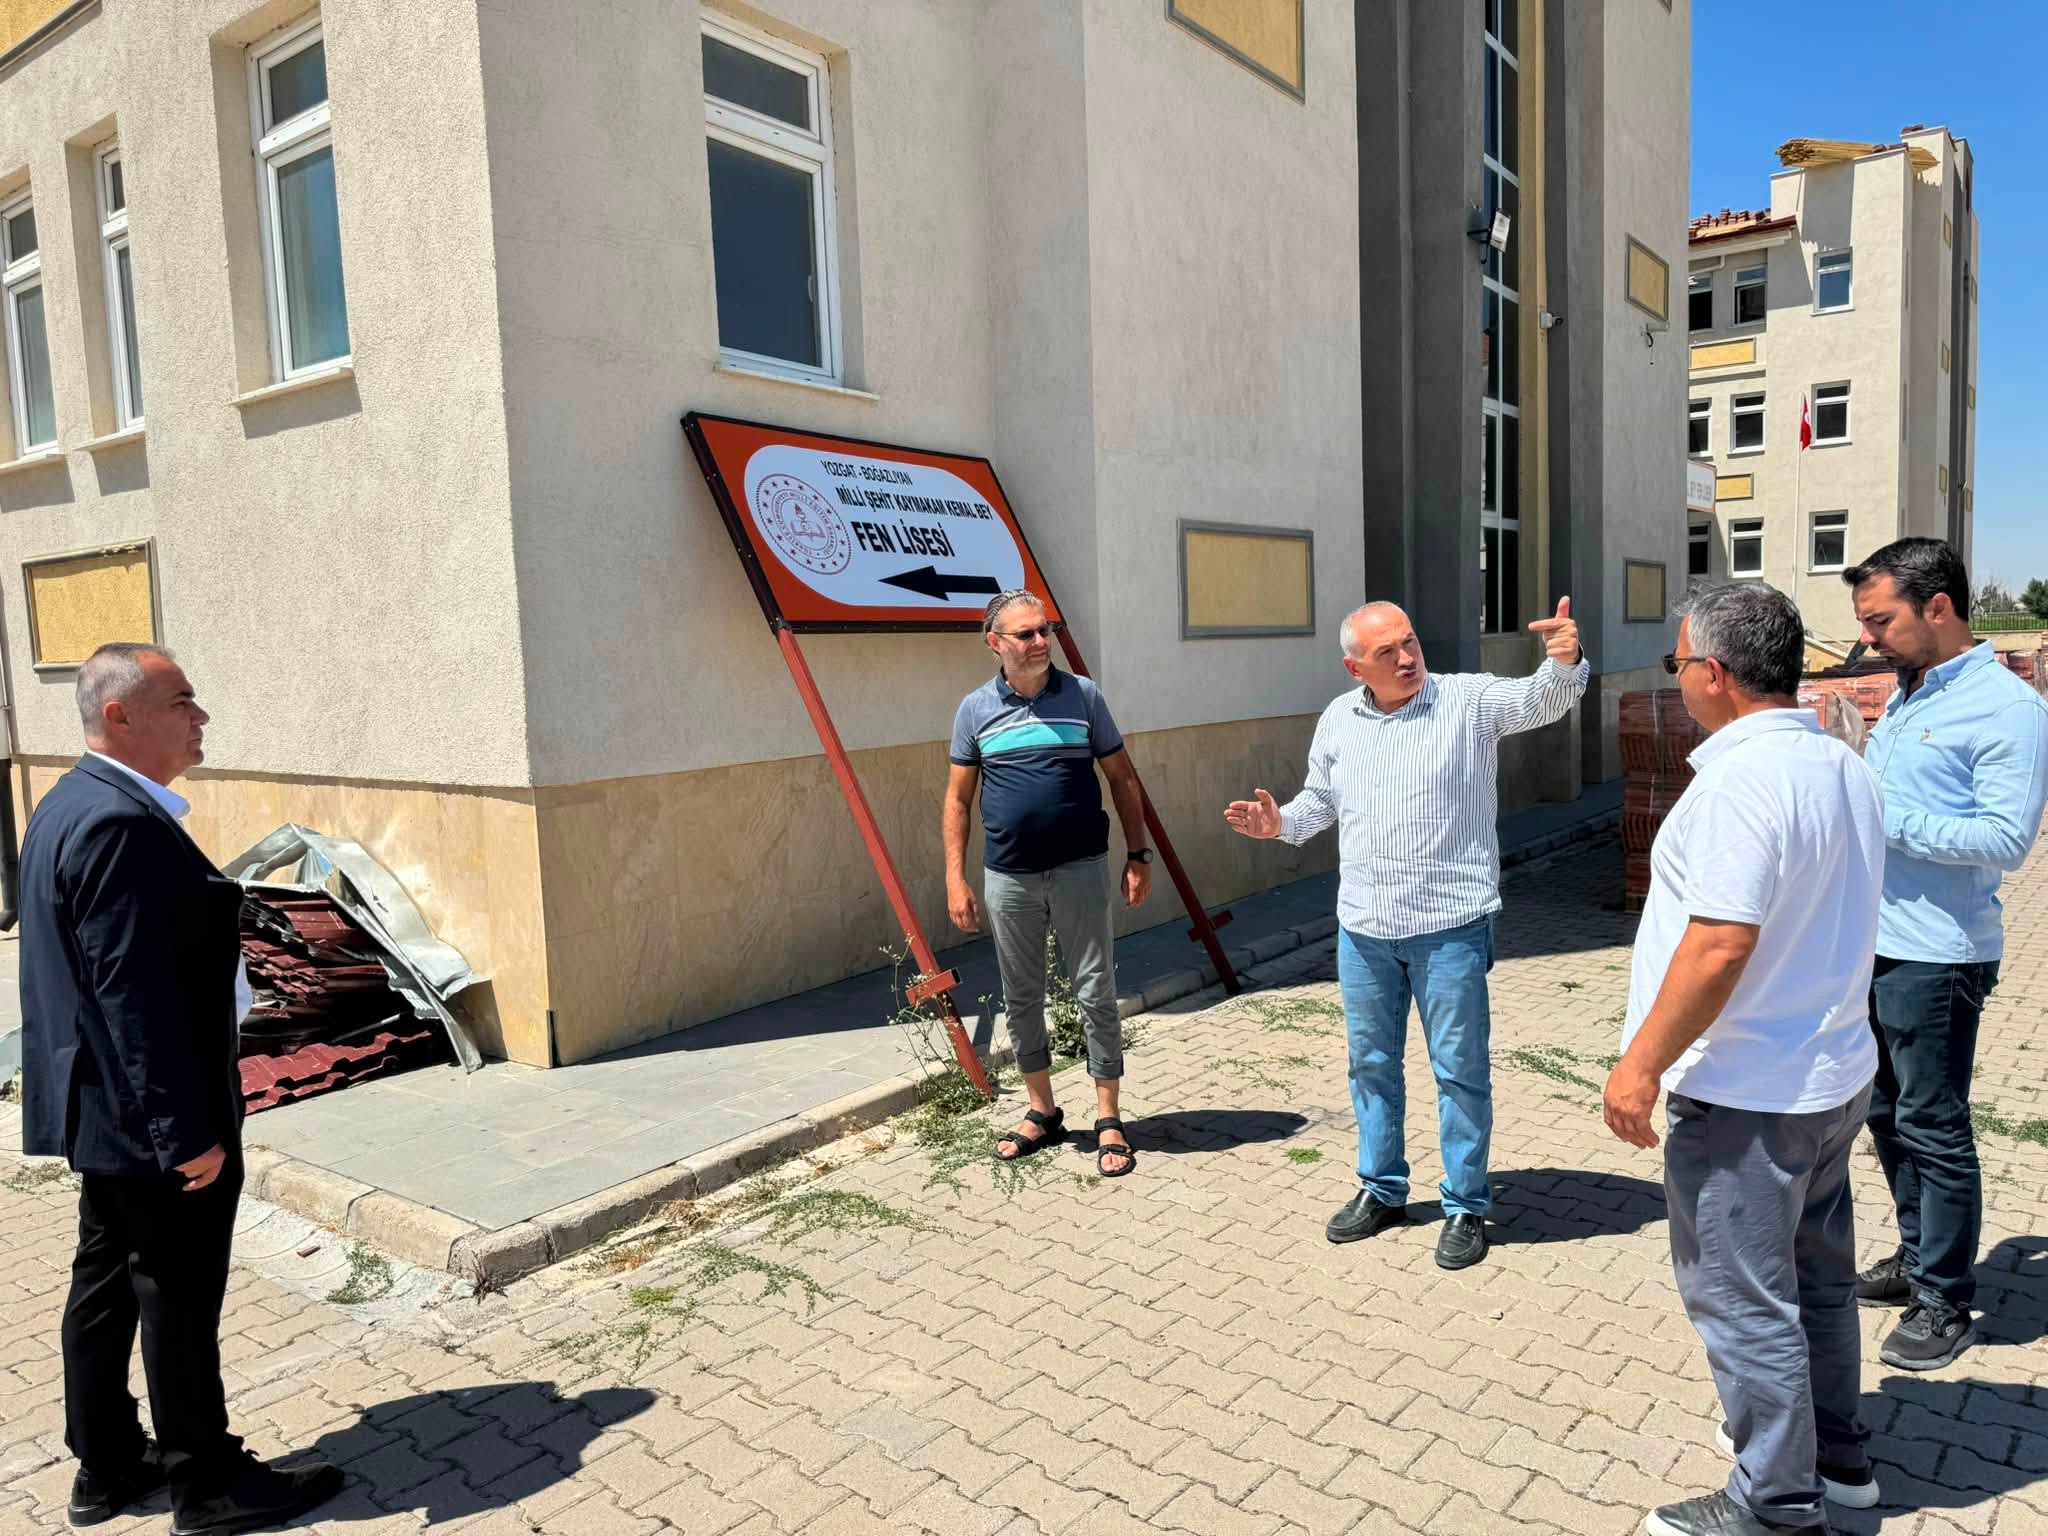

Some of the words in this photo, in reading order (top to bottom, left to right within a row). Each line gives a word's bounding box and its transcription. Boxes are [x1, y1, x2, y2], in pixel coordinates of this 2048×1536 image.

[820, 460, 858, 478] YOZGAT
[861, 465, 913, 485] BOĞAZLIYAN
[835, 484, 867, 507] MİLLİ
[864, 488, 896, 512] ŞEHİT
[893, 494, 949, 516] KAYMAKAM
[945, 498, 978, 518] KEMAL
[974, 503, 994, 520] BEY
[851, 521, 897, 553] FEN
[892, 518, 956, 557] LİSESİ
